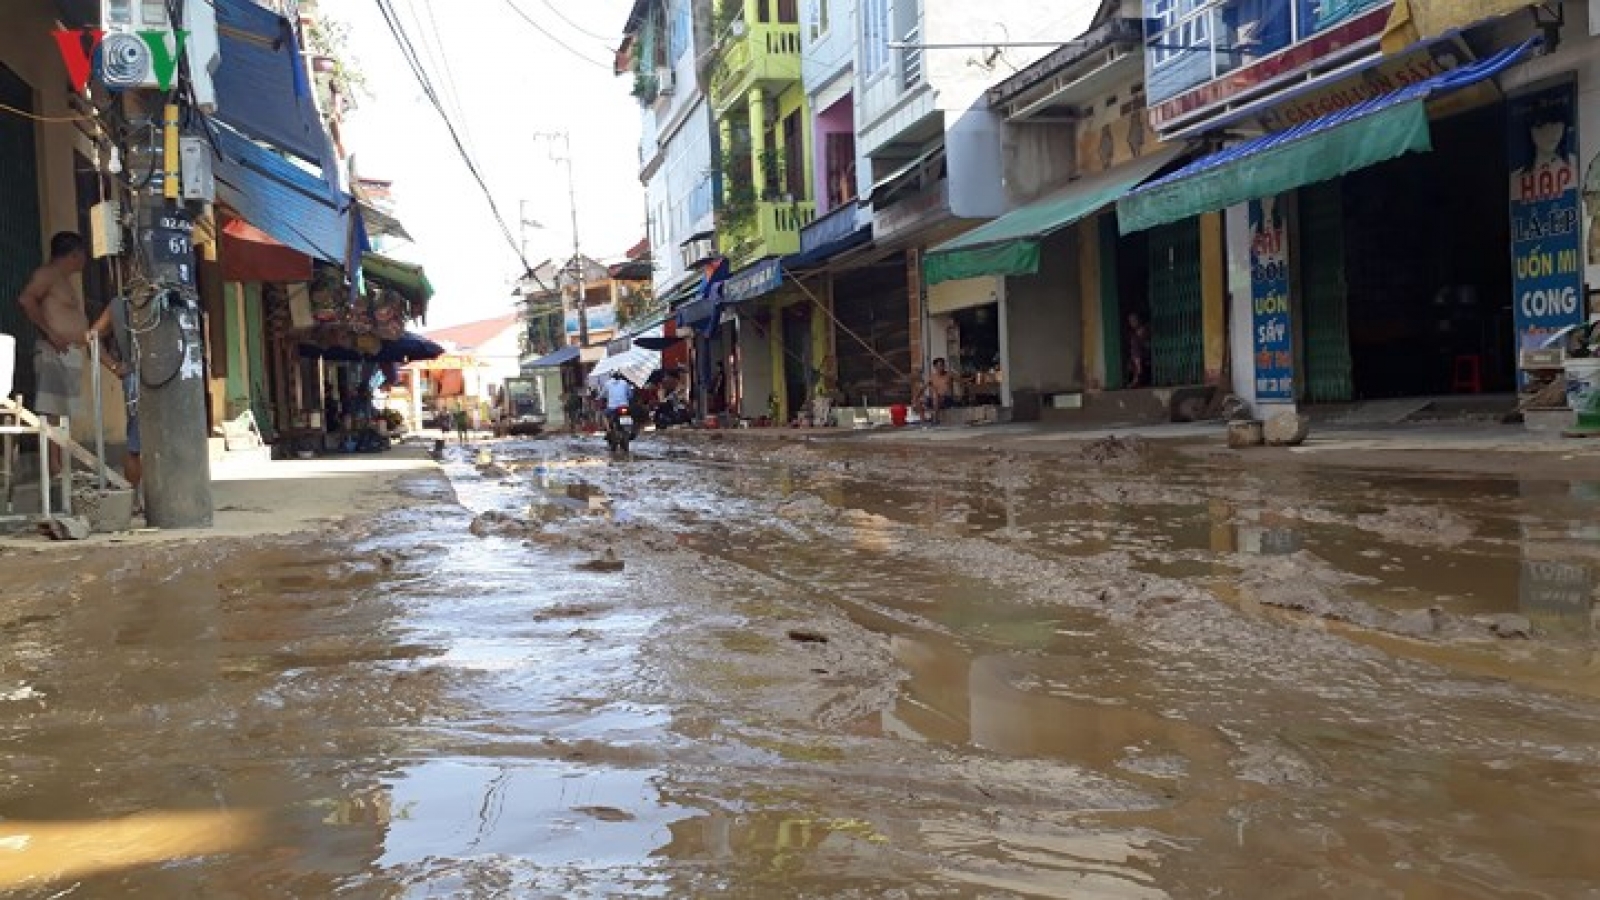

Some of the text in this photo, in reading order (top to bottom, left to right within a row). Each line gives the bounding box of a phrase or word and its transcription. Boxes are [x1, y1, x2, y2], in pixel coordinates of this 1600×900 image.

[1517, 244, 1577, 280] UỐN MI
[1521, 285, 1578, 318] CONG
